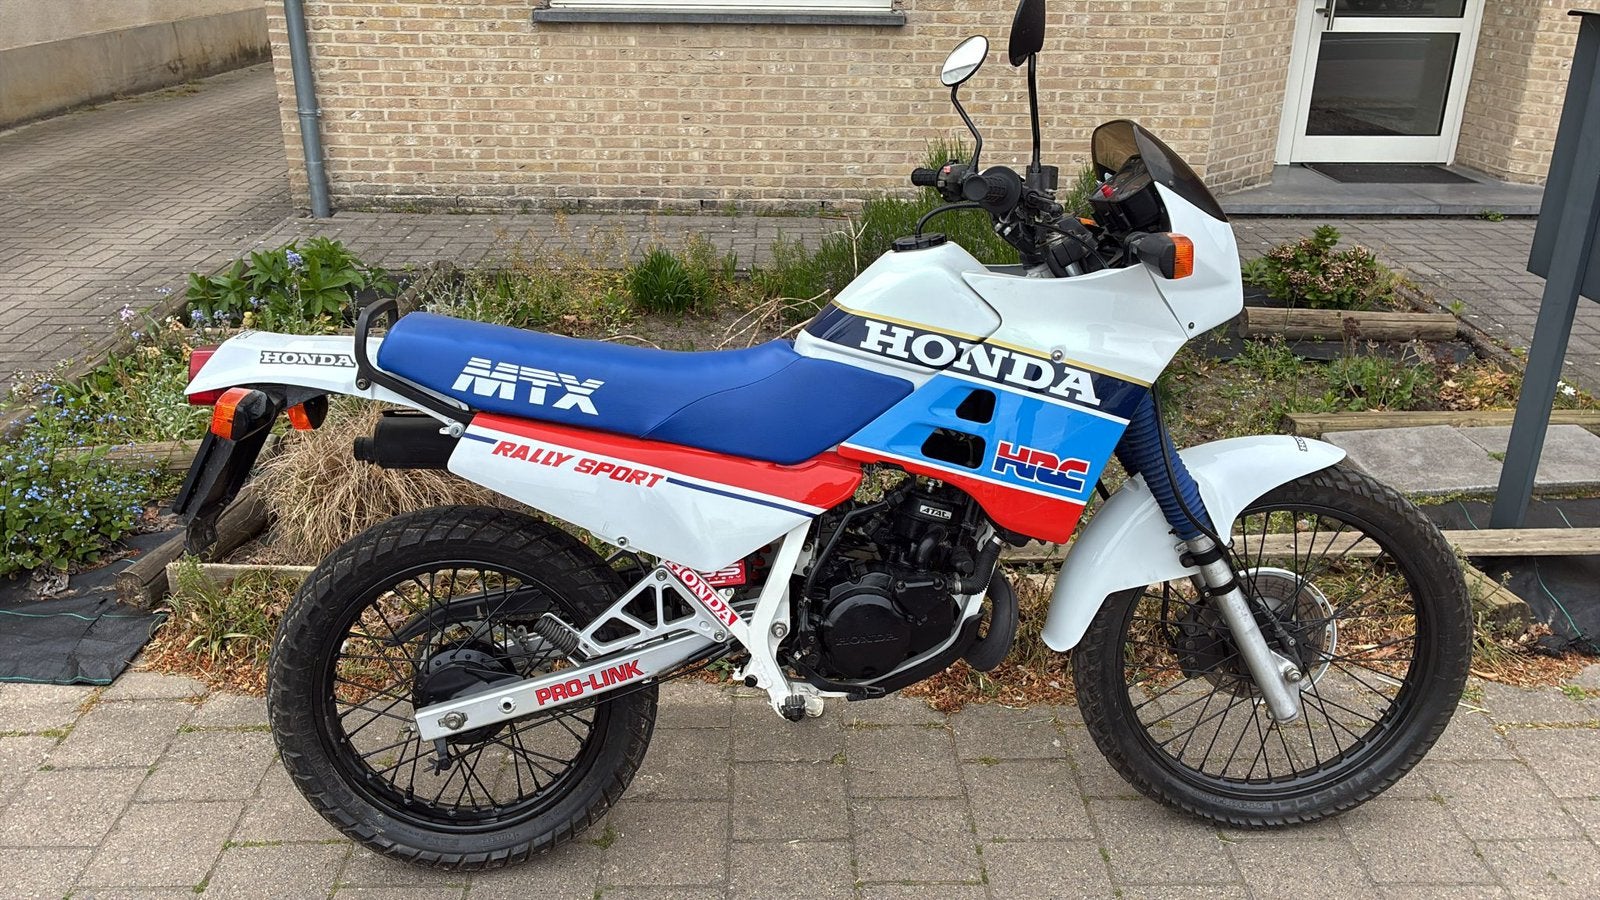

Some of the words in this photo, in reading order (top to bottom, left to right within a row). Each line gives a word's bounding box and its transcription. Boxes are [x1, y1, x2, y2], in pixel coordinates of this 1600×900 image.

[261, 351, 355, 368] HONDA
[859, 319, 1101, 406] HONDA
[451, 356, 606, 416] MTX
[491, 440, 575, 468] RALLY
[573, 458, 665, 488] SPORT
[991, 440, 1092, 494] HRC
[535, 659, 645, 706] PRO-LINK
